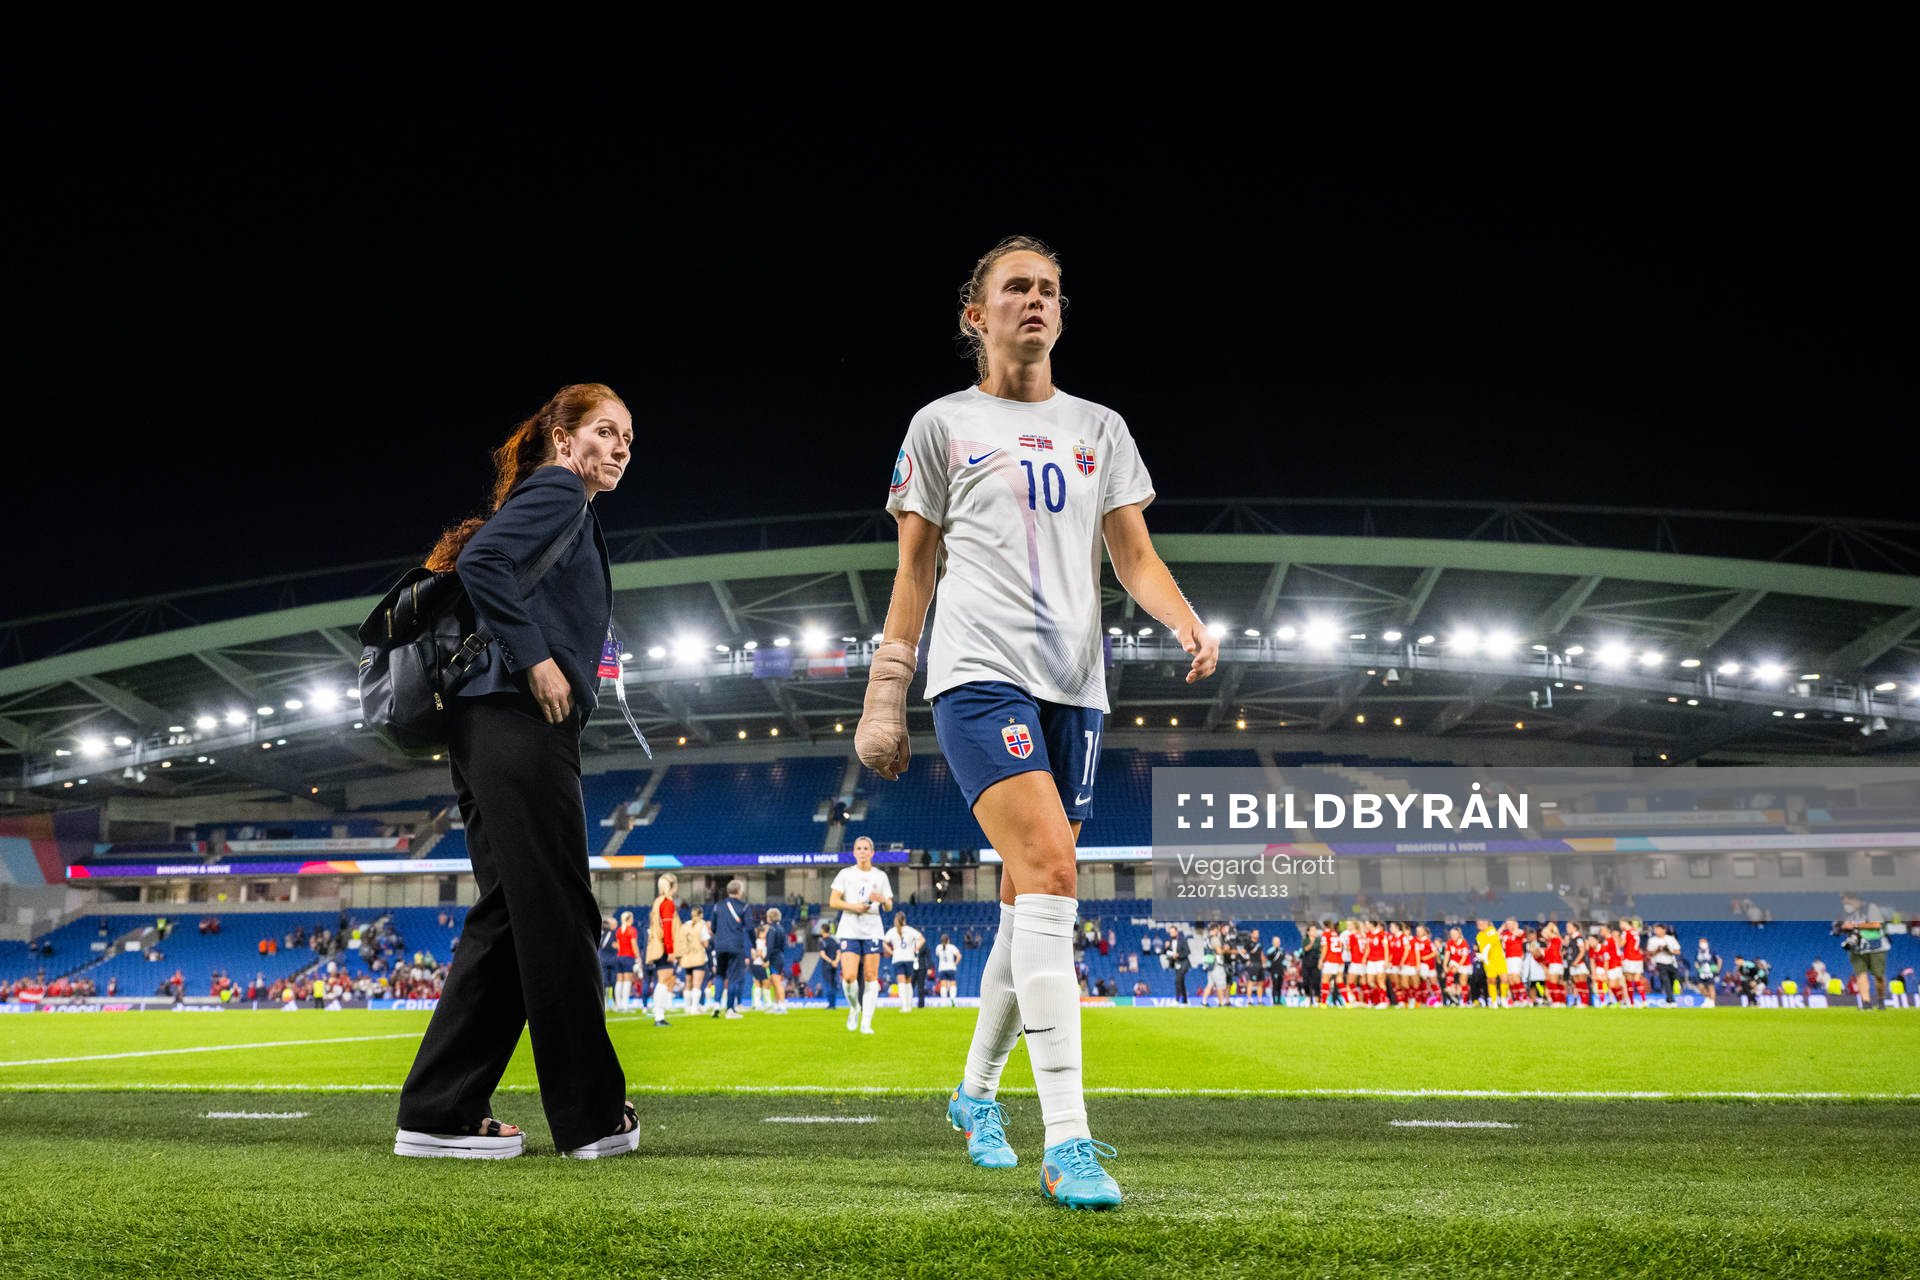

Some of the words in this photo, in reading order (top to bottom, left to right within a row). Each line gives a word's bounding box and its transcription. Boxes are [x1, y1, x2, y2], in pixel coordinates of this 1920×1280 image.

[1020, 460, 1066, 513] 10
[1396, 843, 1446, 853] BRIGHTON
[1449, 843, 1457, 852] &
[1458, 842, 1487, 852] HOVE
[757, 855, 803, 864] BRIGHTON
[804, 855, 812, 863] &
[813, 854, 838, 863] HOVE
[156, 866, 199, 875] BRIGHTON
[207, 865, 231, 874] HOVE
